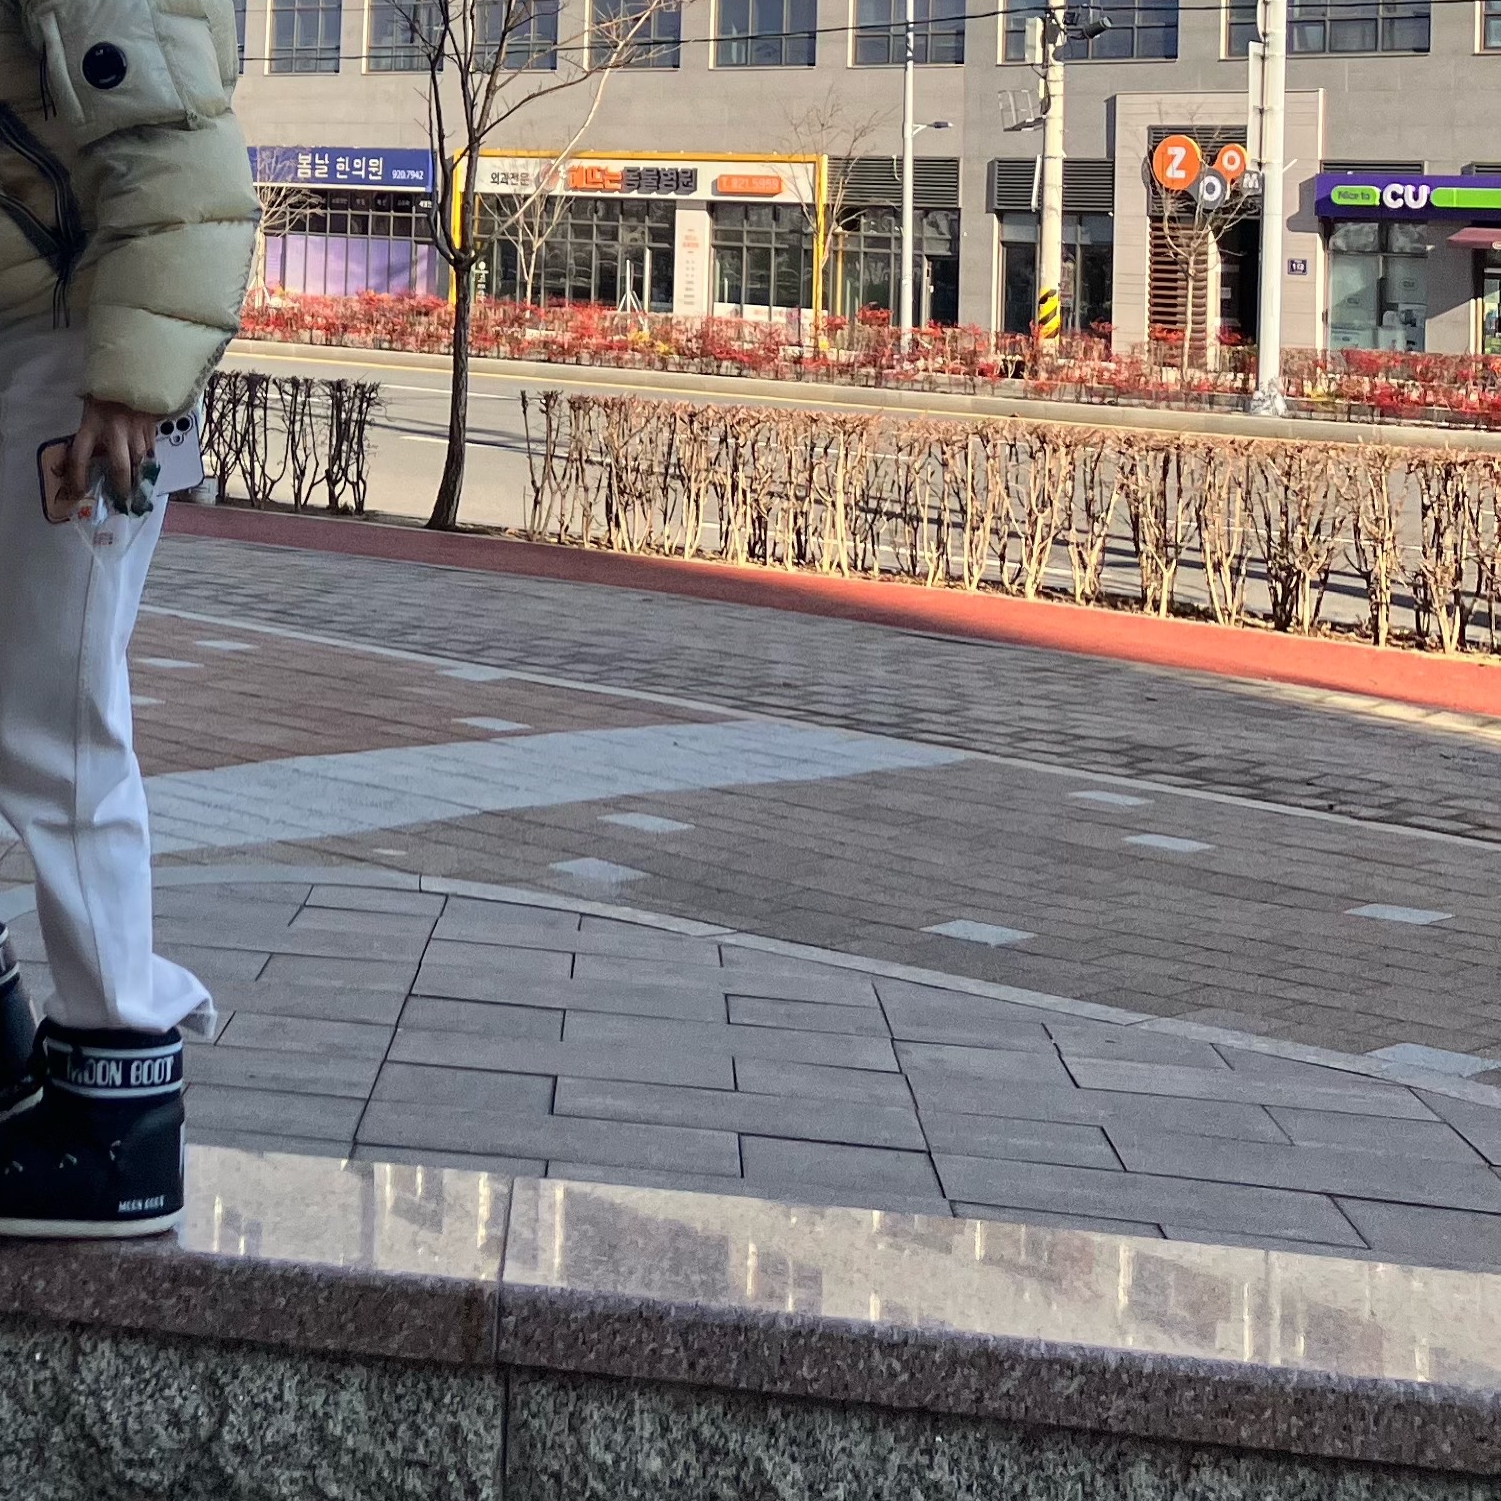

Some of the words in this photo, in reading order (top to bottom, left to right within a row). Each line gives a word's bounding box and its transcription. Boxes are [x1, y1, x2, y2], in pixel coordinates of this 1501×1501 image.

[297, 152, 329, 179] 봄날
[335, 156, 384, 181] 한의원
[490, 171, 530, 187] 외과전문
[1382, 183, 1431, 209] CU
[130, 1055, 175, 1086] BOOT
